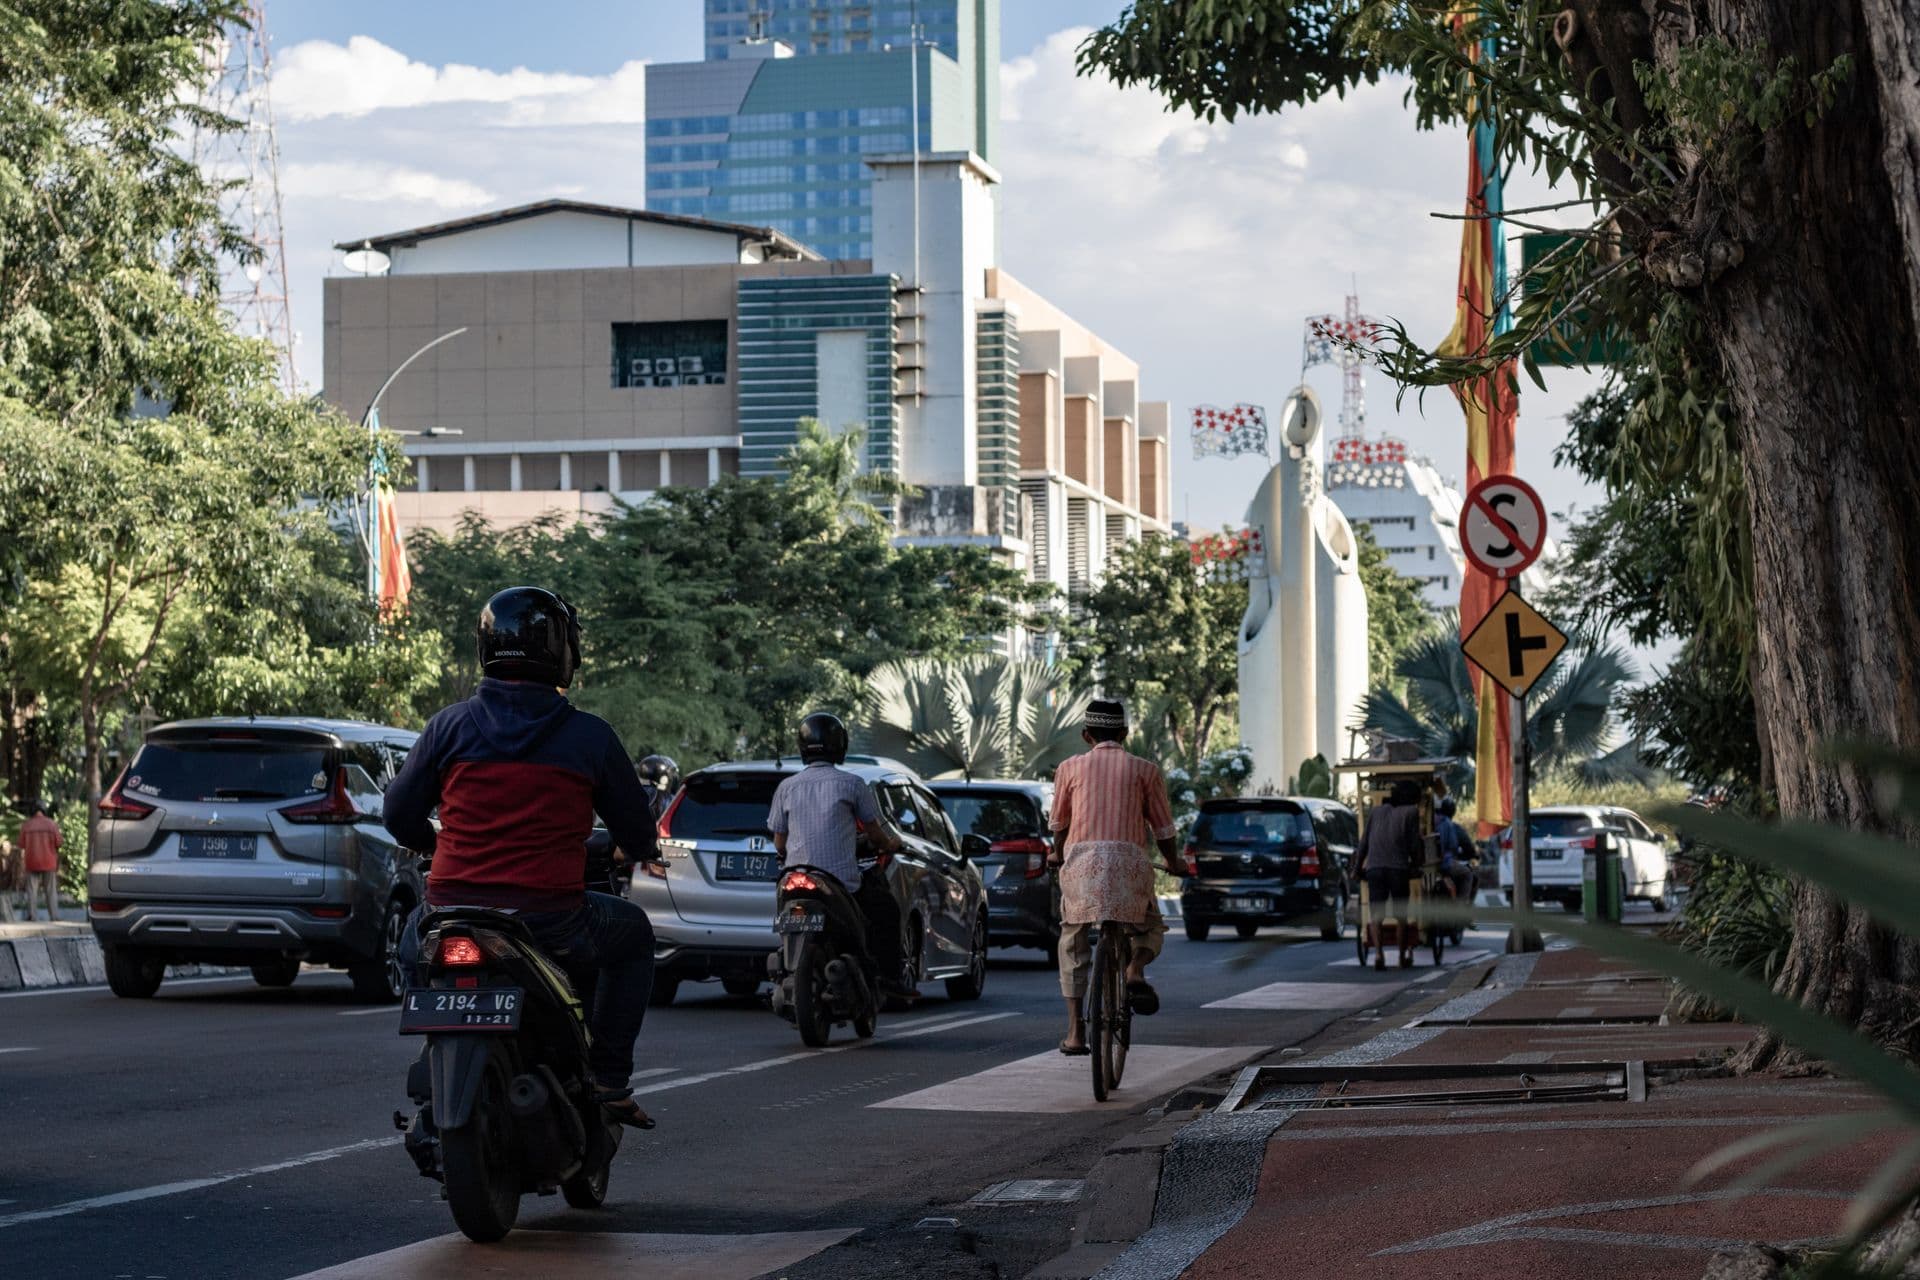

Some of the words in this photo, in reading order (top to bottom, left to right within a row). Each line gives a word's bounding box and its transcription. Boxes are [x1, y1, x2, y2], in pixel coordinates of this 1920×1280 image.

[1486, 493, 1519, 558] S
[181, 837, 188, 850] L
[720, 856, 734, 869] AE
[744, 856, 769, 870] 1757
[409, 995, 419, 1010] L
[435, 995, 477, 1010] 2194
[495, 994, 515, 1010] VG
